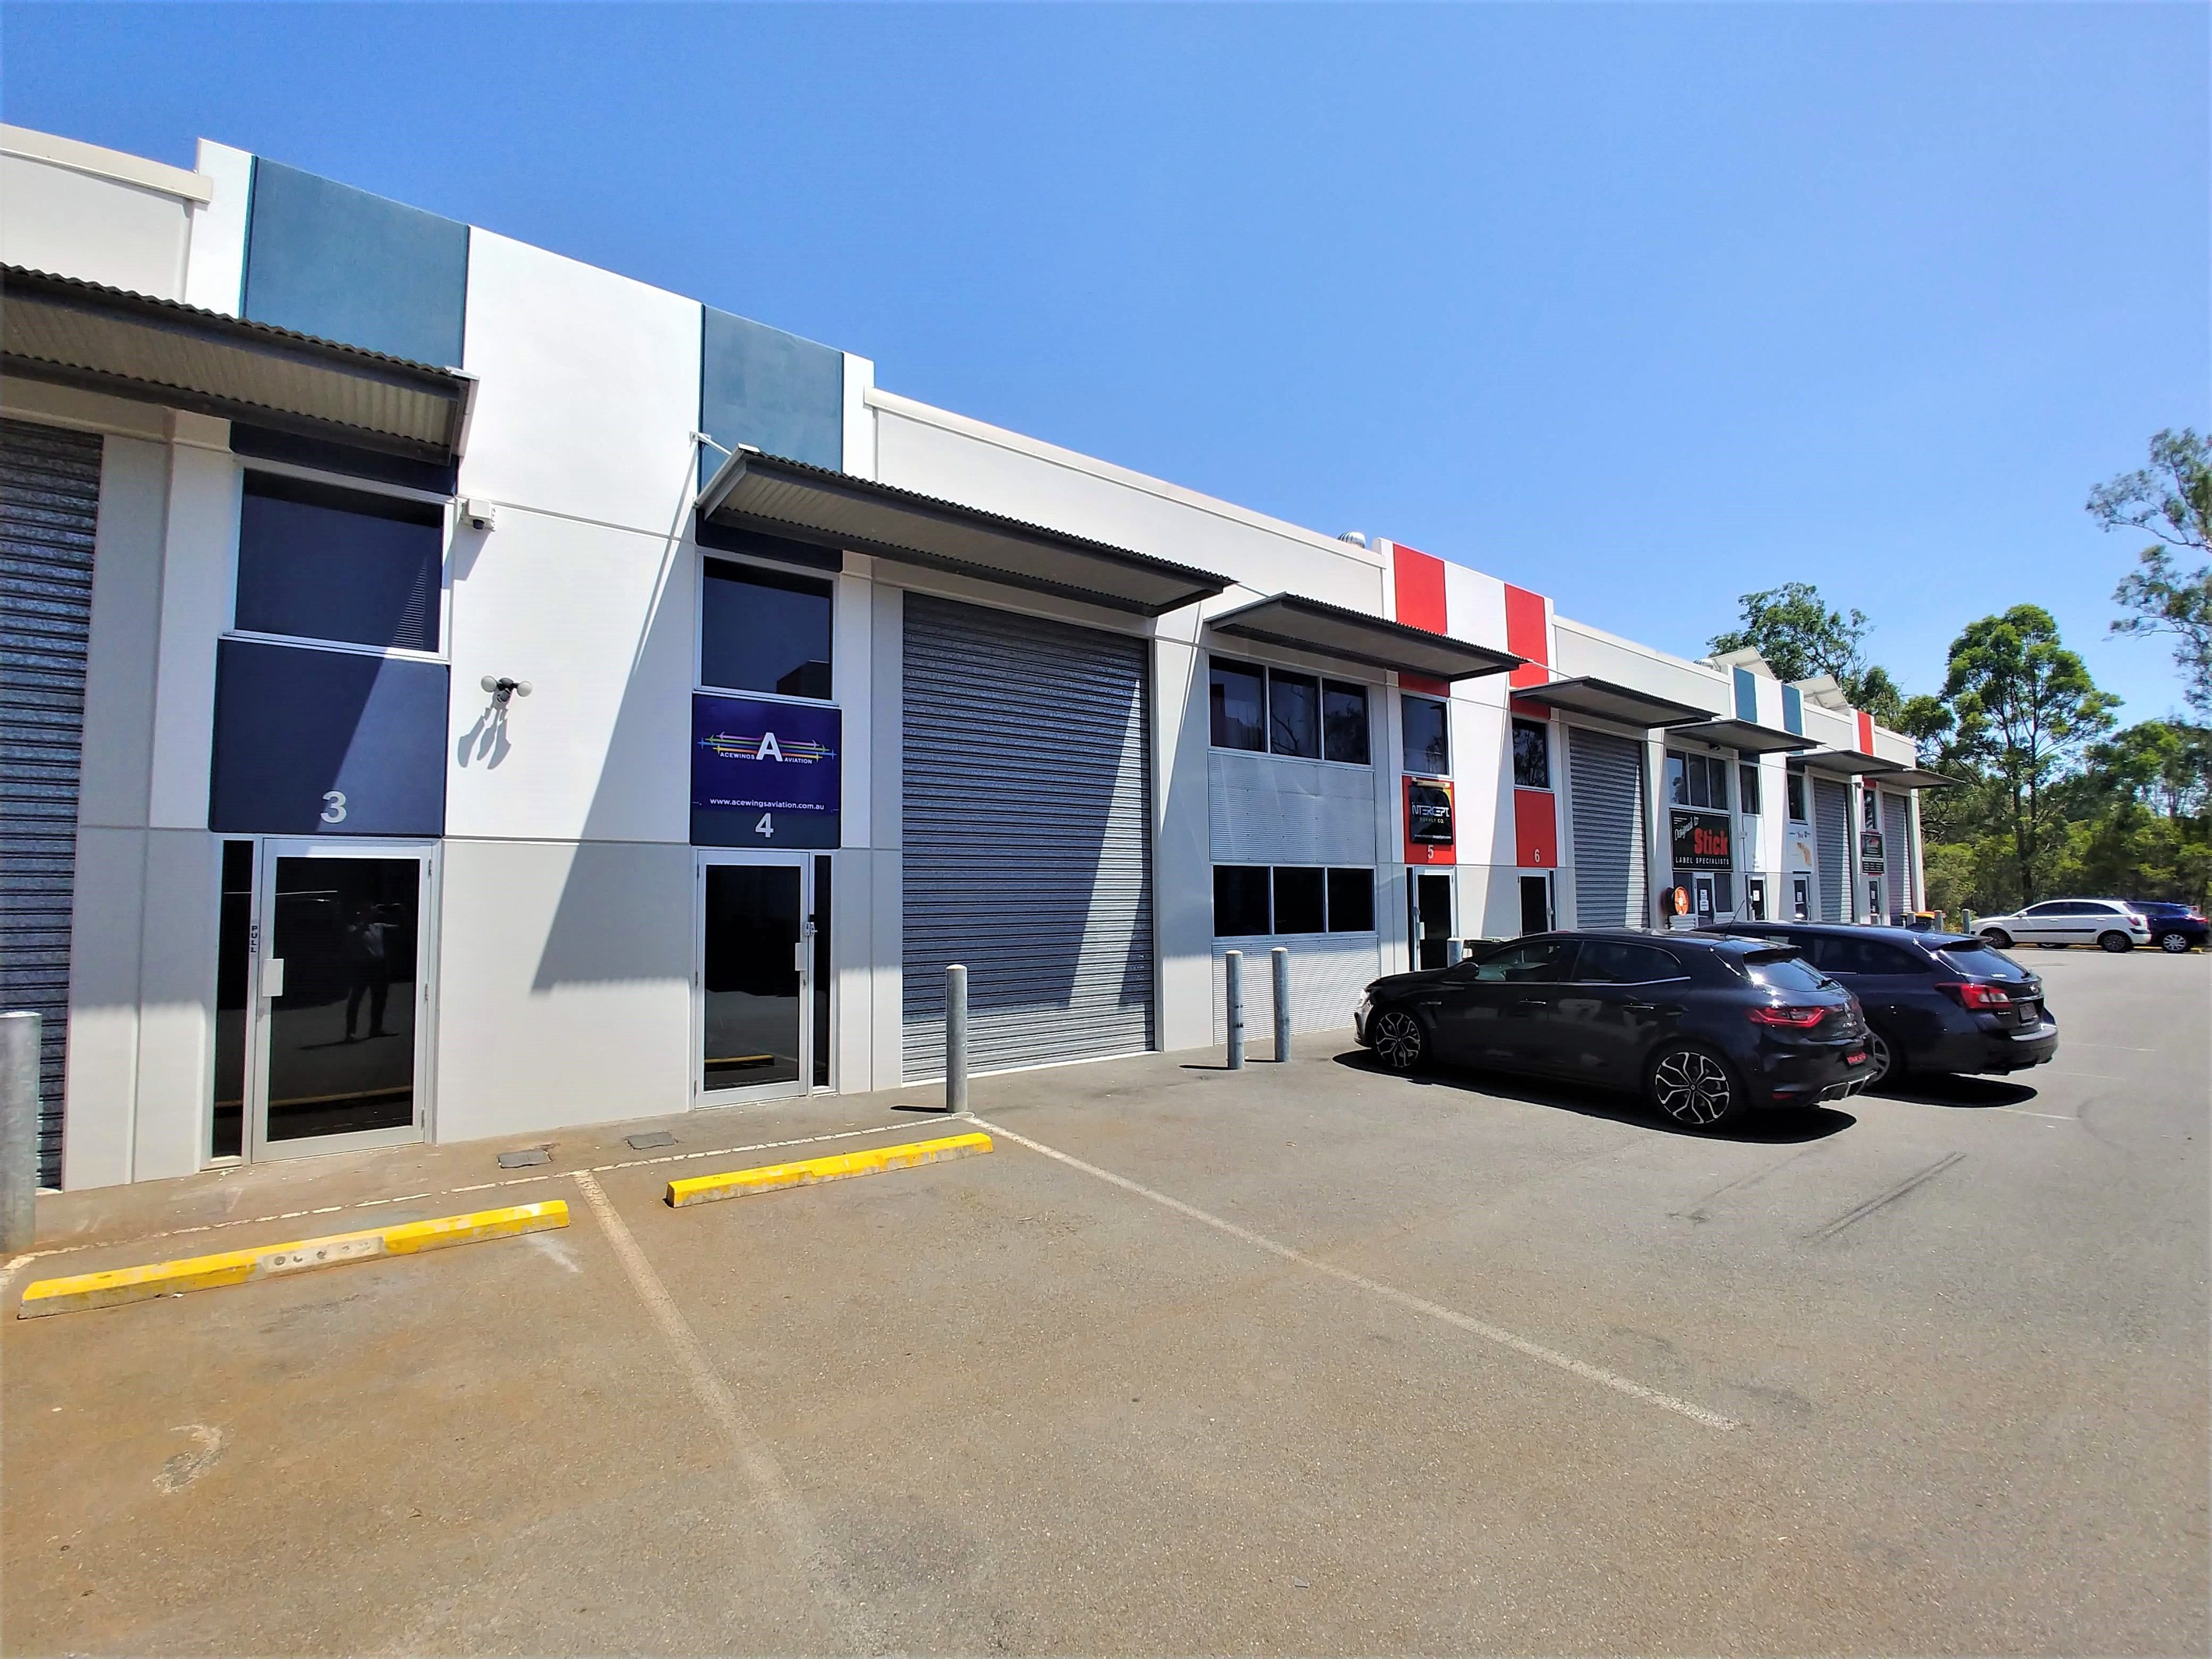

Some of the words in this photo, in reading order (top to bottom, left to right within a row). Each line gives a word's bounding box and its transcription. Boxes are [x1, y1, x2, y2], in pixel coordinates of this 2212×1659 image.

[755, 732, 783, 762] A
[320, 790, 347, 824] 3
[709, 797, 825, 810] www.acewingsaviation.com.au
[754, 812, 775, 838] 4
[1427, 844, 1434, 859] 5
[1693, 828, 1728, 856] Stick
[1534, 849, 1541, 863] 6
[1696, 857, 1729, 866] SPECIALISTS
[250, 925, 258, 953] PULL
